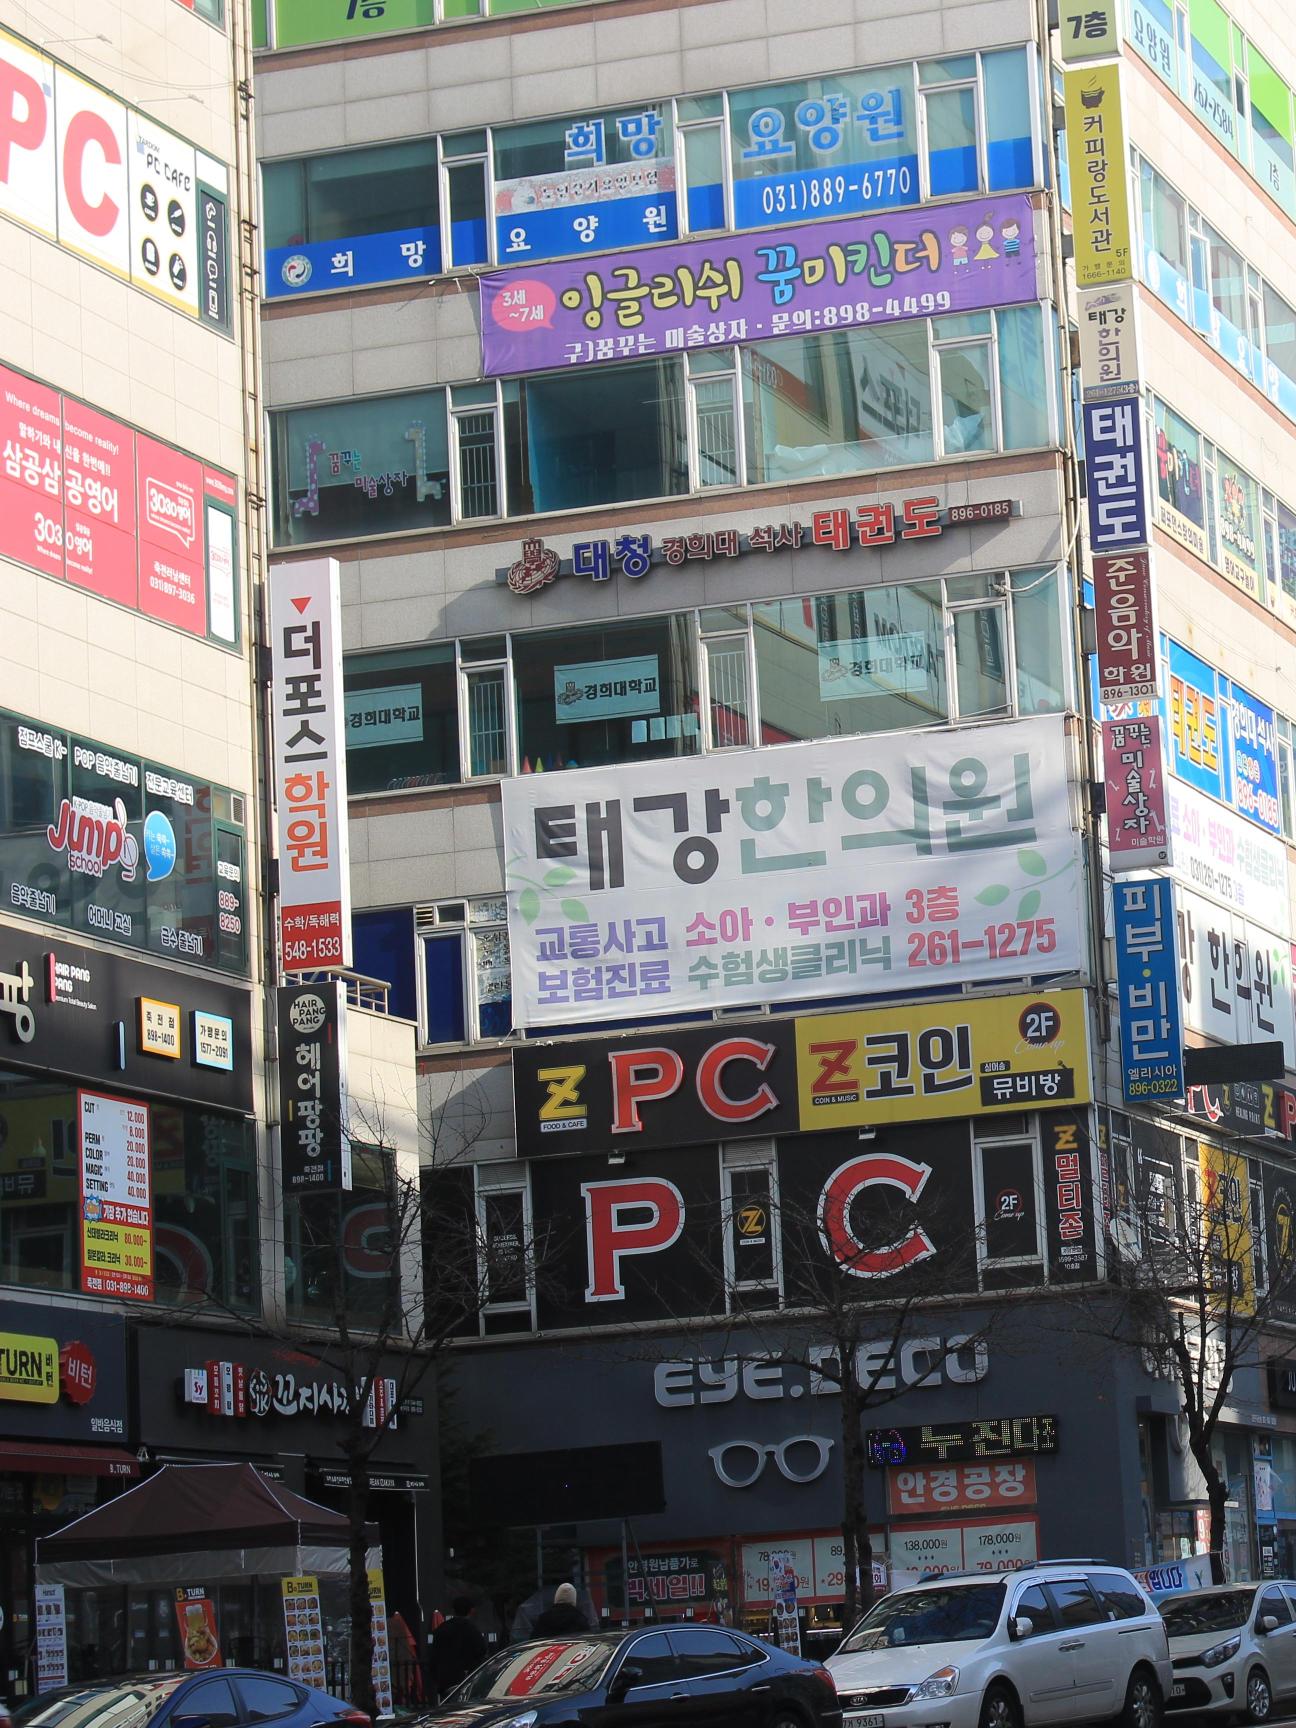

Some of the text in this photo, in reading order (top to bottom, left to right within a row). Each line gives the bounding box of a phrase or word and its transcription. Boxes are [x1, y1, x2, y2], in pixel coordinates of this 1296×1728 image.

[1067, 12, 1108, 39] 7층
[1133, 10, 1171, 77] 요양원
[565, 87, 906, 165] 희망 요양원
[146, 154, 191, 192] PC CAFE
[1083, 114, 1112, 253] 커피랑도서관
[762, 167, 911, 214] 031)889-6770
[1116, 248, 1128, 257] 5F
[561, 230, 941, 330] 잉글리쉬 꿈미킨더
[1082, 267, 1126, 280] 1666-1140
[502, 289, 526, 306] 3세
[1088, 307, 1126, 326] 태강
[665, 319, 748, 349] 미술상자
[1098, 327, 1122, 382] 한의원
[5, 391, 94, 442] Where dreams become
[3, 440, 119, 523] 삼공삼공영어
[353, 467, 408, 498] 미술상자
[1091, 405, 1140, 543] 태권도
[573, 496, 1010, 581] 대청 경희대 석사 태권도 896-0185
[849, 654, 924, 678] 경희대학교
[1104, 662, 1151, 685] 학원
[584, 676, 658, 700] 경희대학교
[1104, 684, 1155, 700] 896-1301
[349, 704, 421, 729] 경희대학교
[282, 620, 330, 873] 더포스학원
[18, 726, 194, 805] 점프스쿨 음악줄넘기 전문교육센터
[1121, 752, 1150, 834] 미술상자
[48, 799, 123, 867] Jump
[1130, 834, 1165, 847] 미술학원
[69, 854, 103, 877] school
[10, 883, 56, 915] 음악줄넘기
[114, 913, 132, 936] 교실
[219, 913, 241, 935] 8250
[283, 911, 340, 931] 수학/독해력
[535, 885, 960, 962] 교통사고 소아 부인과 3층
[178, 930, 204, 955] 줄넘기
[285, 936, 341, 961] 548-1533
[537, 916, 1056, 1006] 보험진료 수험생클리닉 261-1275
[1208, 926, 1275, 1034] 한의원
[293, 1000, 318, 1010] HAIR
[299, 1006, 326, 1016] PANG
[292, 1016, 320, 1026] PANG
[1025, 1011, 1054, 1039] 2F
[147, 1028, 175, 1047] 898-1400
[864, 1024, 974, 1100] 코인
[1127, 1064, 1177, 1080] 엘리시아
[537, 1036, 780, 1134] Z PC
[992, 1073, 1061, 1101] 뮤비방
[1129, 1079, 1178, 1096] 896-0322
[295, 1042, 324, 1158] 헤어팡팡
[814, 1094, 858, 1104] COIN MUSIC
[84, 1101, 145, 1125] CUT 12.000
[543, 1119, 585, 1131] FOOD CAFE
[85, 1132, 145, 1154] PERM 20.000
[85, 1147, 104, 1161] COLOR
[85, 1162, 104, 1177] MAGIC
[86, 1178, 109, 1193] SETTING
[999, 1195, 1018, 1212] 2F
[68, 1358, 92, 1389] 비턴
[91, 1417, 123, 1434] 일반음식점
[897, 1464, 1027, 1504] 안경공장
[904, 1537, 948, 1551] 138,000원
[978, 1532, 1023, 1546] 178,000원
